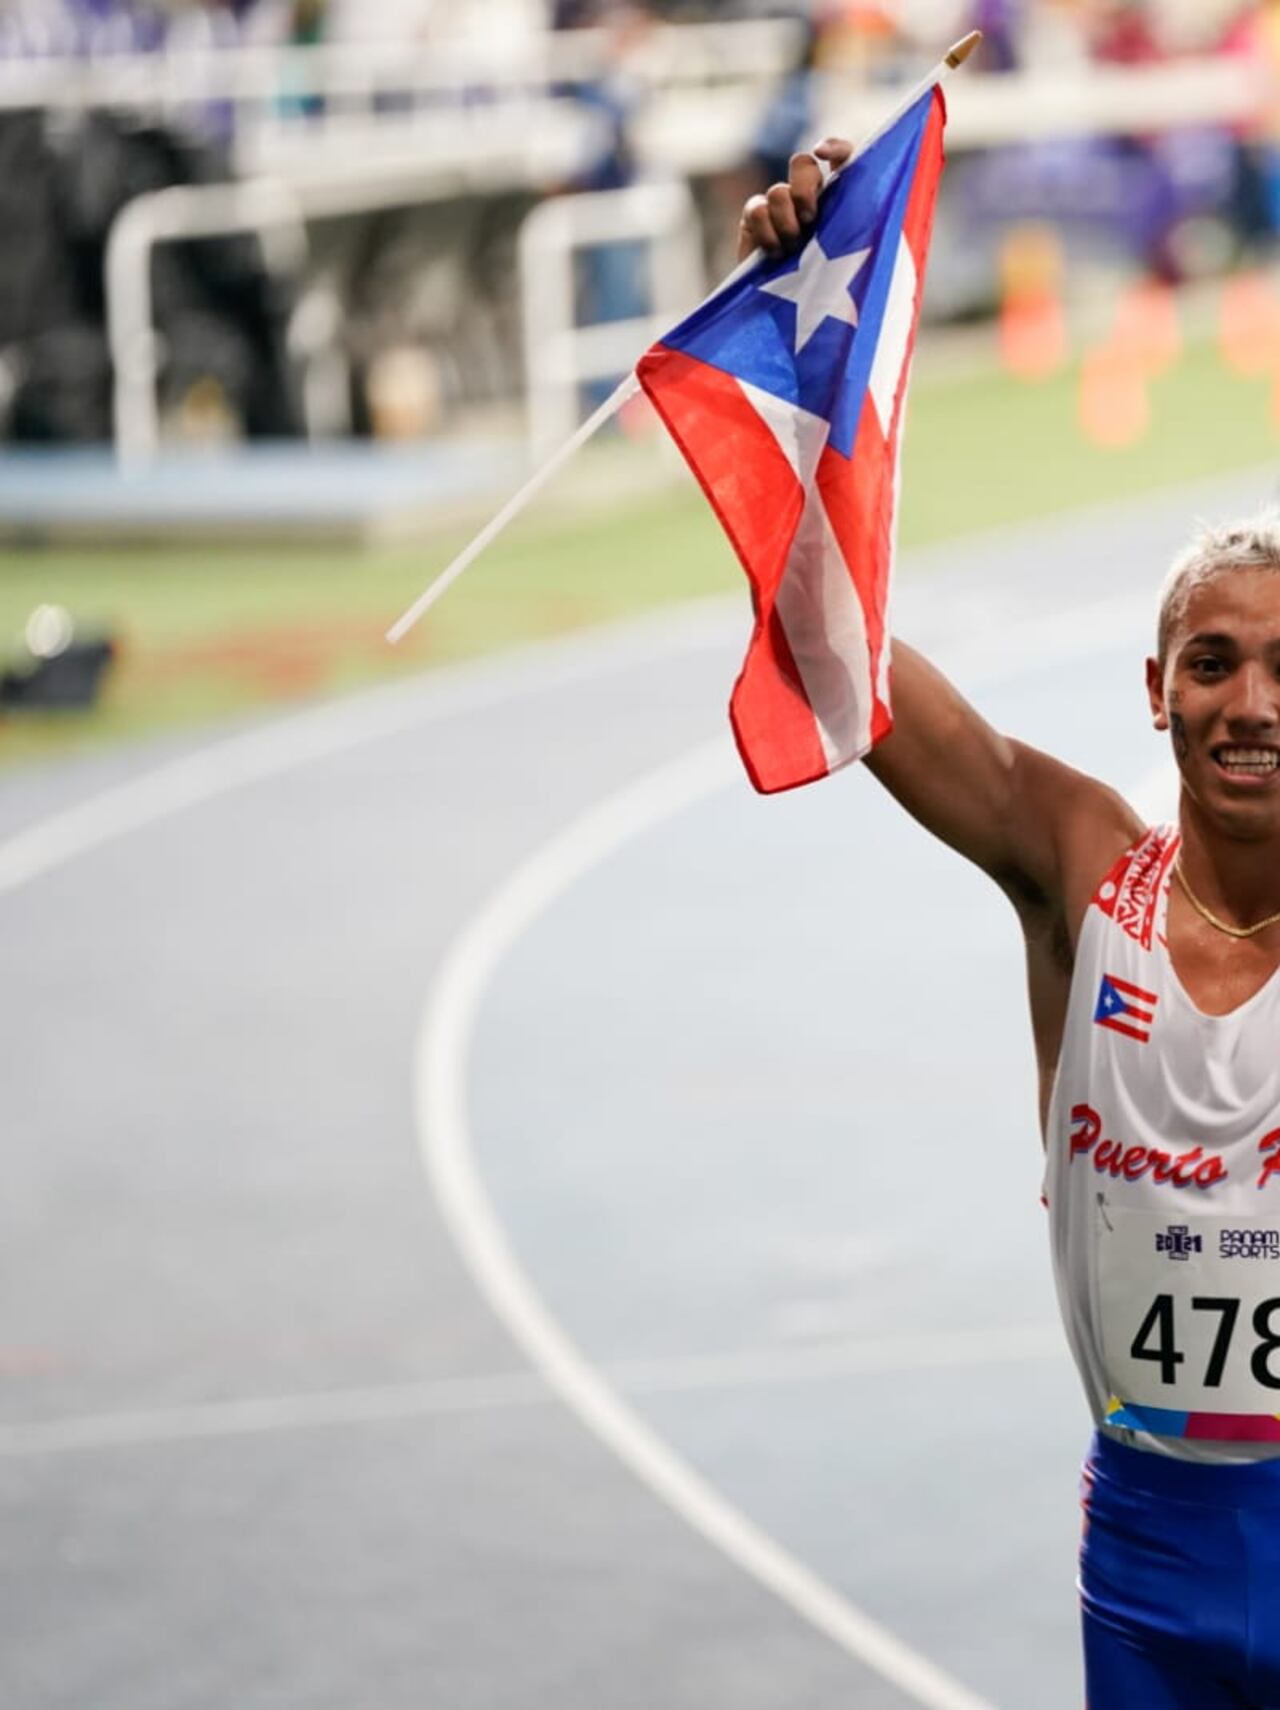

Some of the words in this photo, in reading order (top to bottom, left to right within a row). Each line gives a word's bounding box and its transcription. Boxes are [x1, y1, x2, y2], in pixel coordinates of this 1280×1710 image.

[1069, 1103, 1228, 1189] Puerto
[1219, 1229, 1280, 1244] PANAM
[1219, 1244, 1280, 1259] SPORTS
